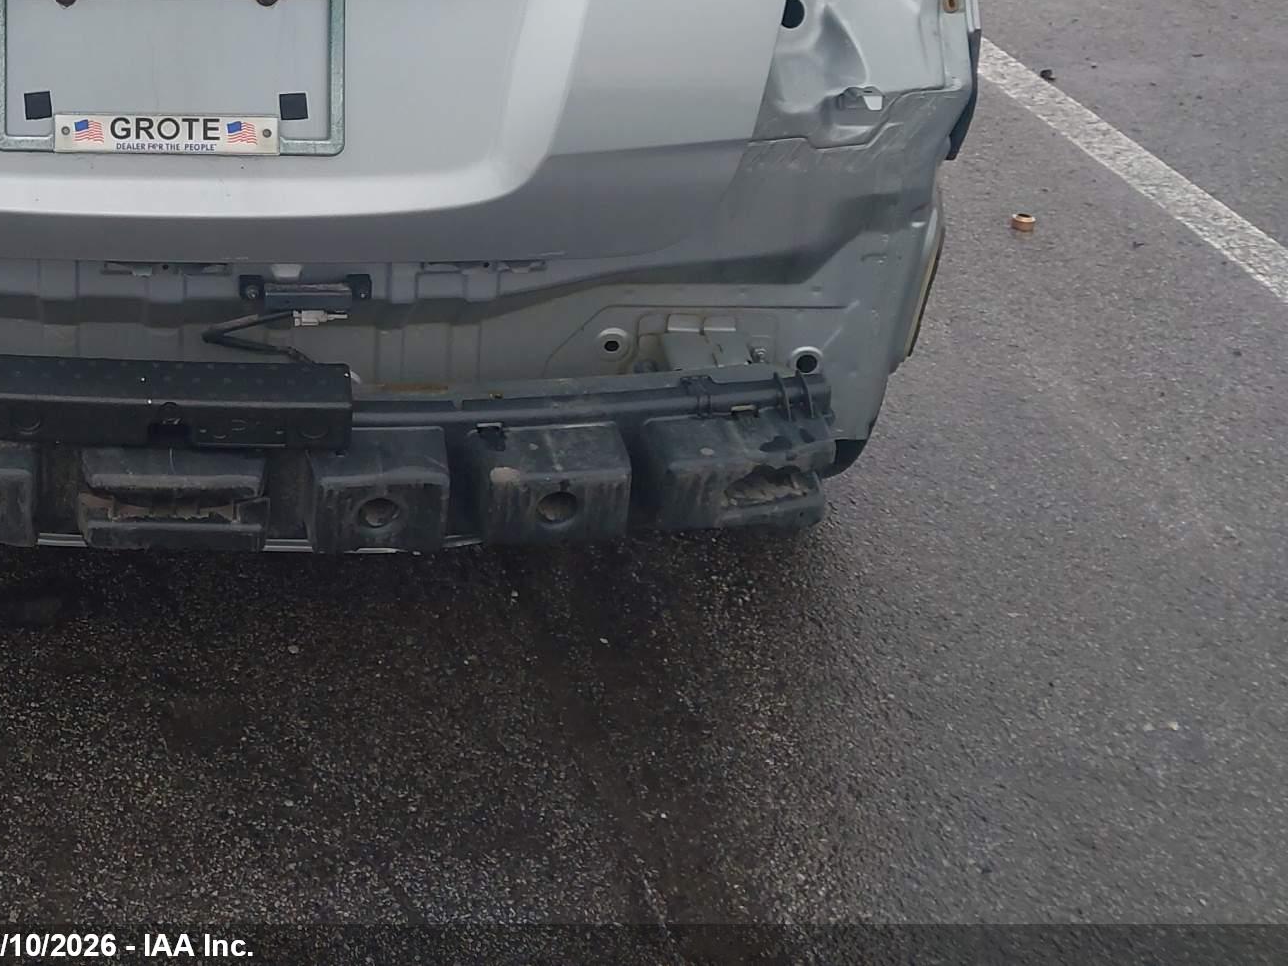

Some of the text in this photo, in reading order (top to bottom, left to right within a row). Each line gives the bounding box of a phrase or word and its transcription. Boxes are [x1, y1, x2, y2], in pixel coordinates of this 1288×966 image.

[110, 117, 220, 140] GROTE
[116, 142, 145, 151] DEALER
[165, 143, 181, 151] THE
[184, 143, 215, 151] PEOPLE
